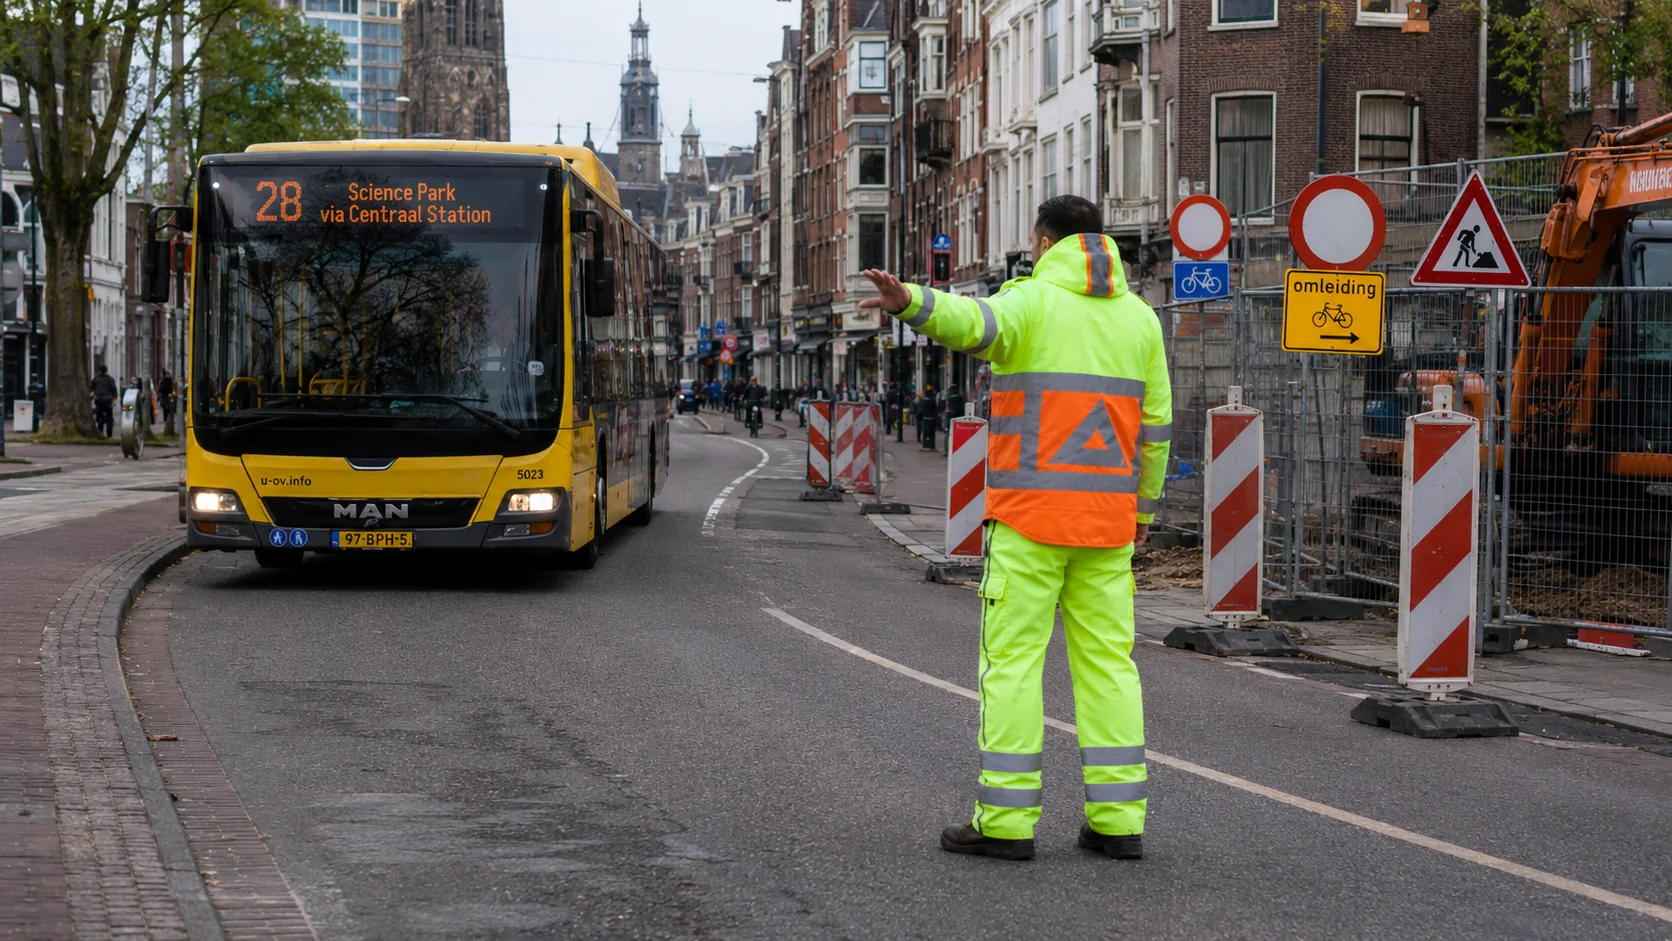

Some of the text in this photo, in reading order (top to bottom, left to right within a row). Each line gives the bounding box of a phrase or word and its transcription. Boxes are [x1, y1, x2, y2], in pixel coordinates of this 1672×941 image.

[348, 182, 456, 201] Science Park
[256, 180, 302, 222] 28
[320, 204, 491, 223] via Centraal Station
[1293, 278, 1376, 299] omleiding
[260, 475, 312, 487] u-ov.info
[517, 469, 544, 480] 5023
[333, 503, 409, 519] MAN
[345, 533, 407, 546] 97-BPH-5
